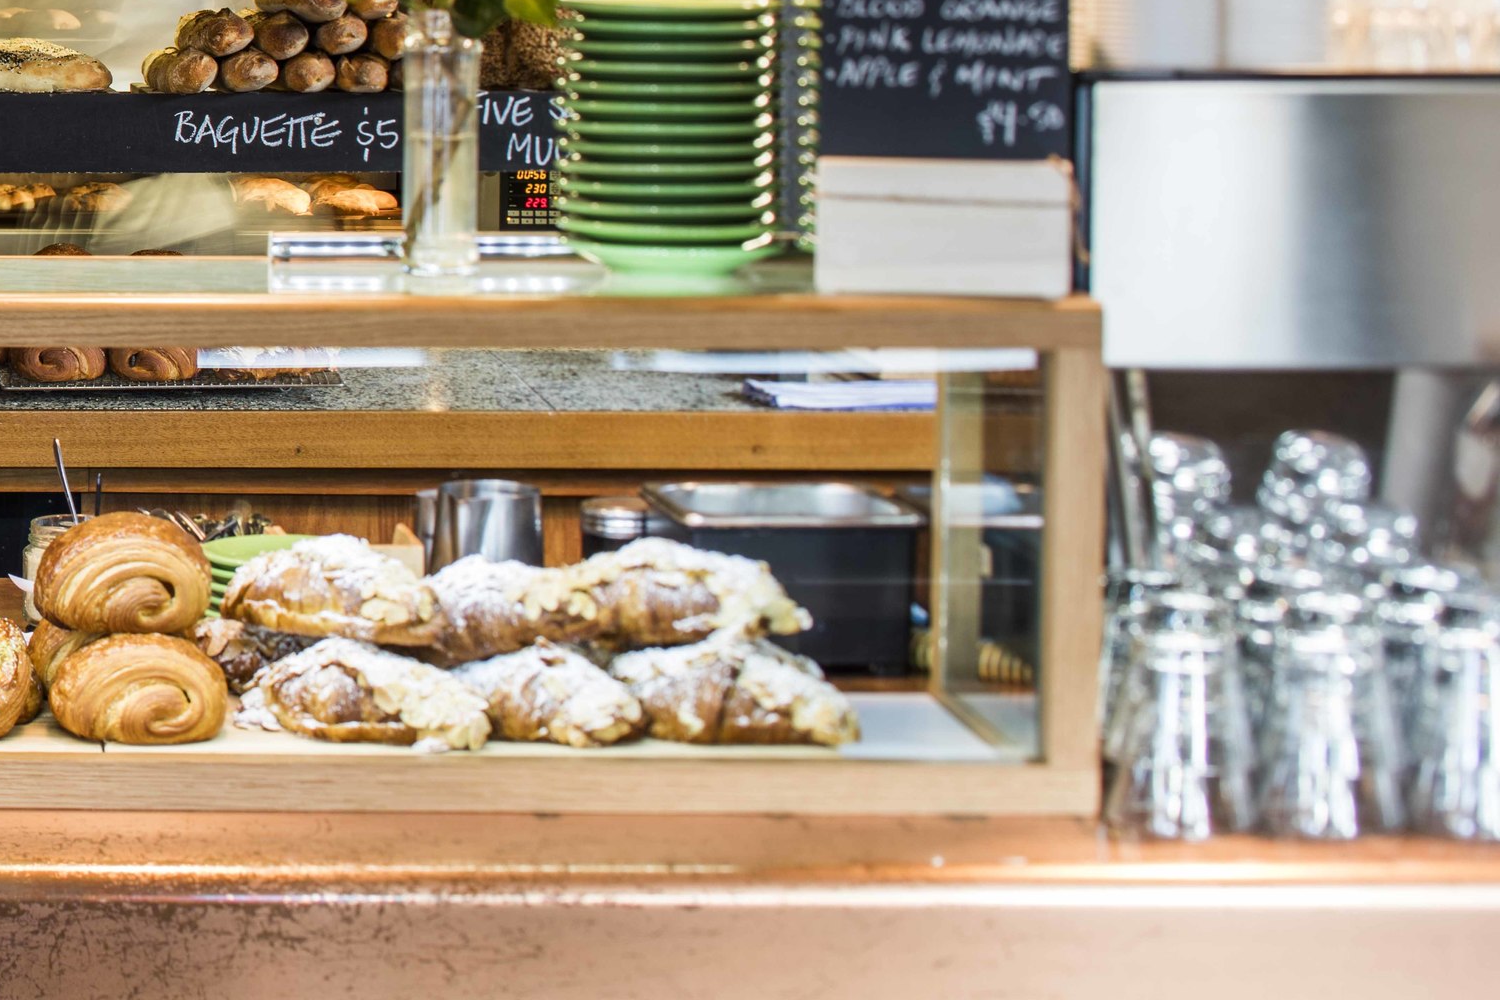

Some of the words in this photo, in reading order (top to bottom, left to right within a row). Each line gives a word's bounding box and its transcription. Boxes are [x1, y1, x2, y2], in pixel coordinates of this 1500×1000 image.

[835, 20, 913, 56] PINK
[920, 24, 1068, 61] LEMONADE
[836, 55, 921, 90] APPLE
[953, 59, 1059, 97] MINT
[173, 110, 343, 155] BAGUETTE
[356, 106, 399, 163] $5
[525, 183, 547, 194] 230
